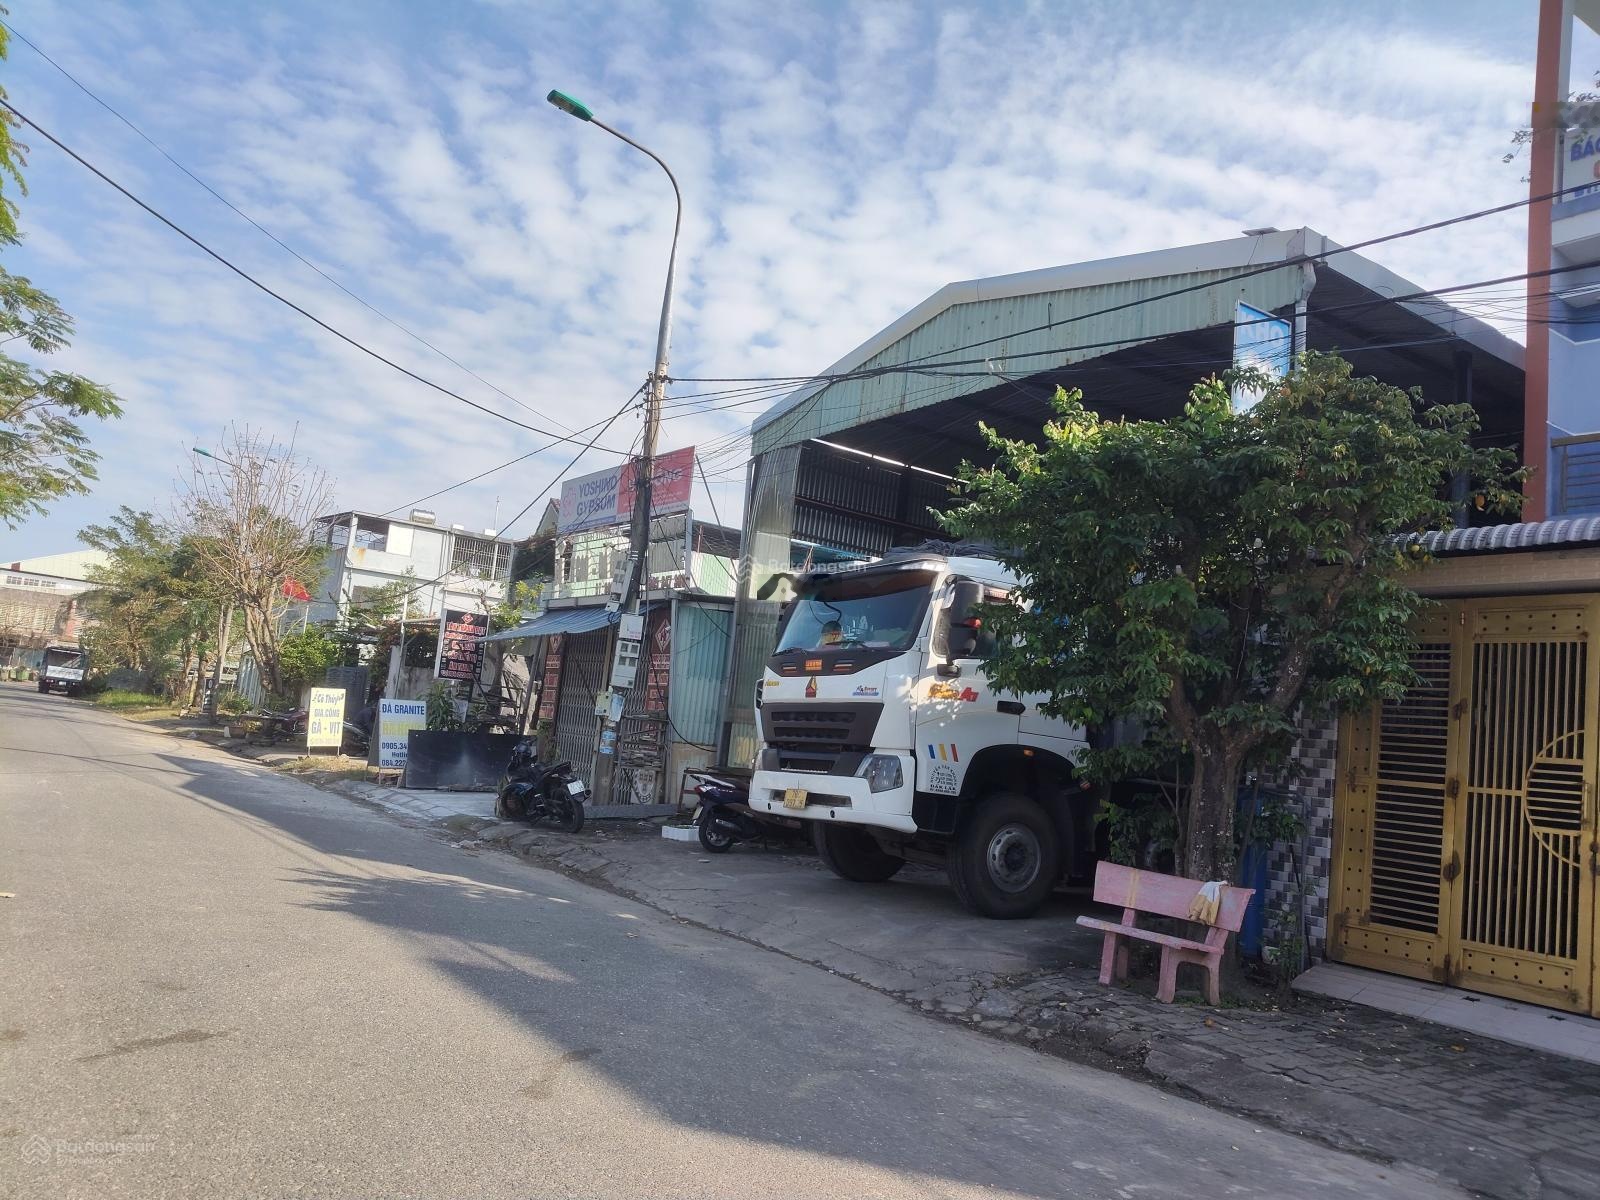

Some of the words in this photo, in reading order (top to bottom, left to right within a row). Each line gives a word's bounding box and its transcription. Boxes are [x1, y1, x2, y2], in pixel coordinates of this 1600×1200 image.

[578, 475, 618, 497] YOSHINO
[576, 494, 616, 516] GYPSUM
[394, 704, 425, 715] GRANITE
